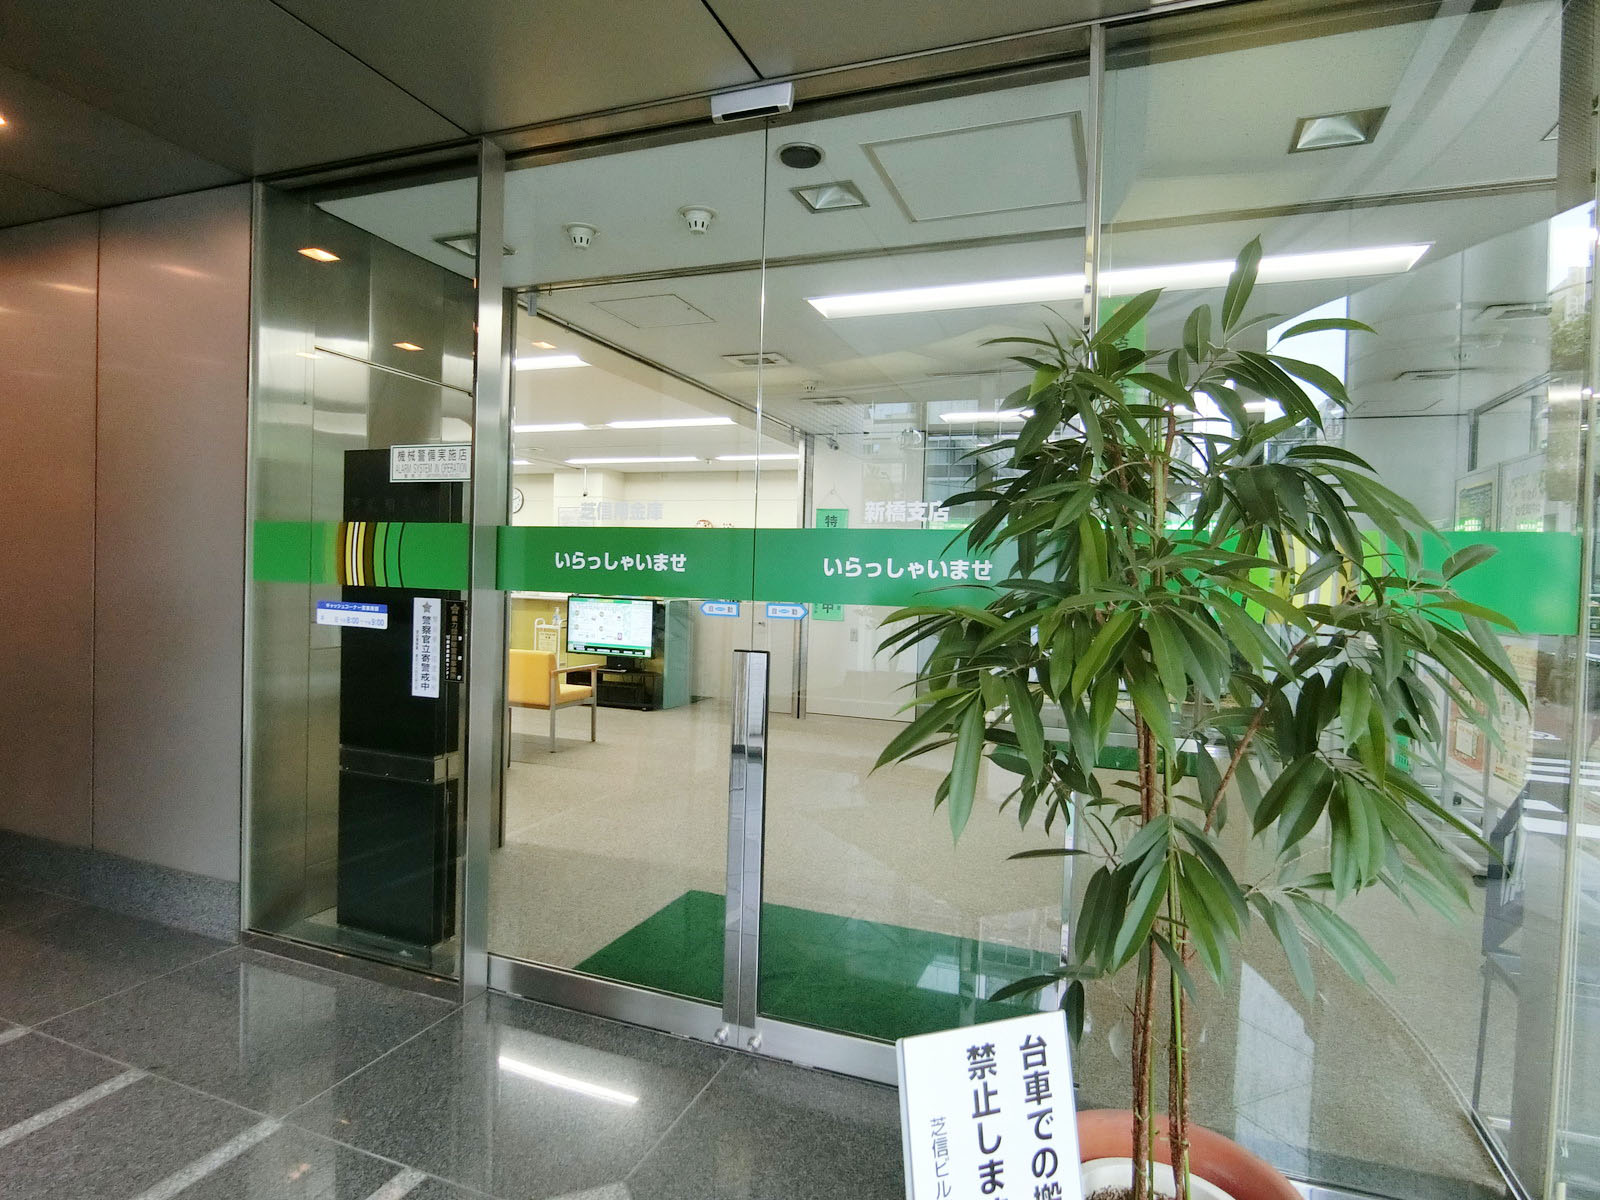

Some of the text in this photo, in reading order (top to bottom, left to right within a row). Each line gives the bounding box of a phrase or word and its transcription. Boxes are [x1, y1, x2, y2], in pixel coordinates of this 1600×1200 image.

[414, 463, 432, 474] SYSTEM
[441, 463, 467, 473] OPERATION
[864, 501, 950, 523] 新橋支店
[554, 552, 687, 572] いらっしゃいませ
[823, 556, 993, 581] いらっしゃいませ
[420, 615, 432, 691] 警察官立寄警戒中
[966, 1042, 1008, 1200] 禁止しま
